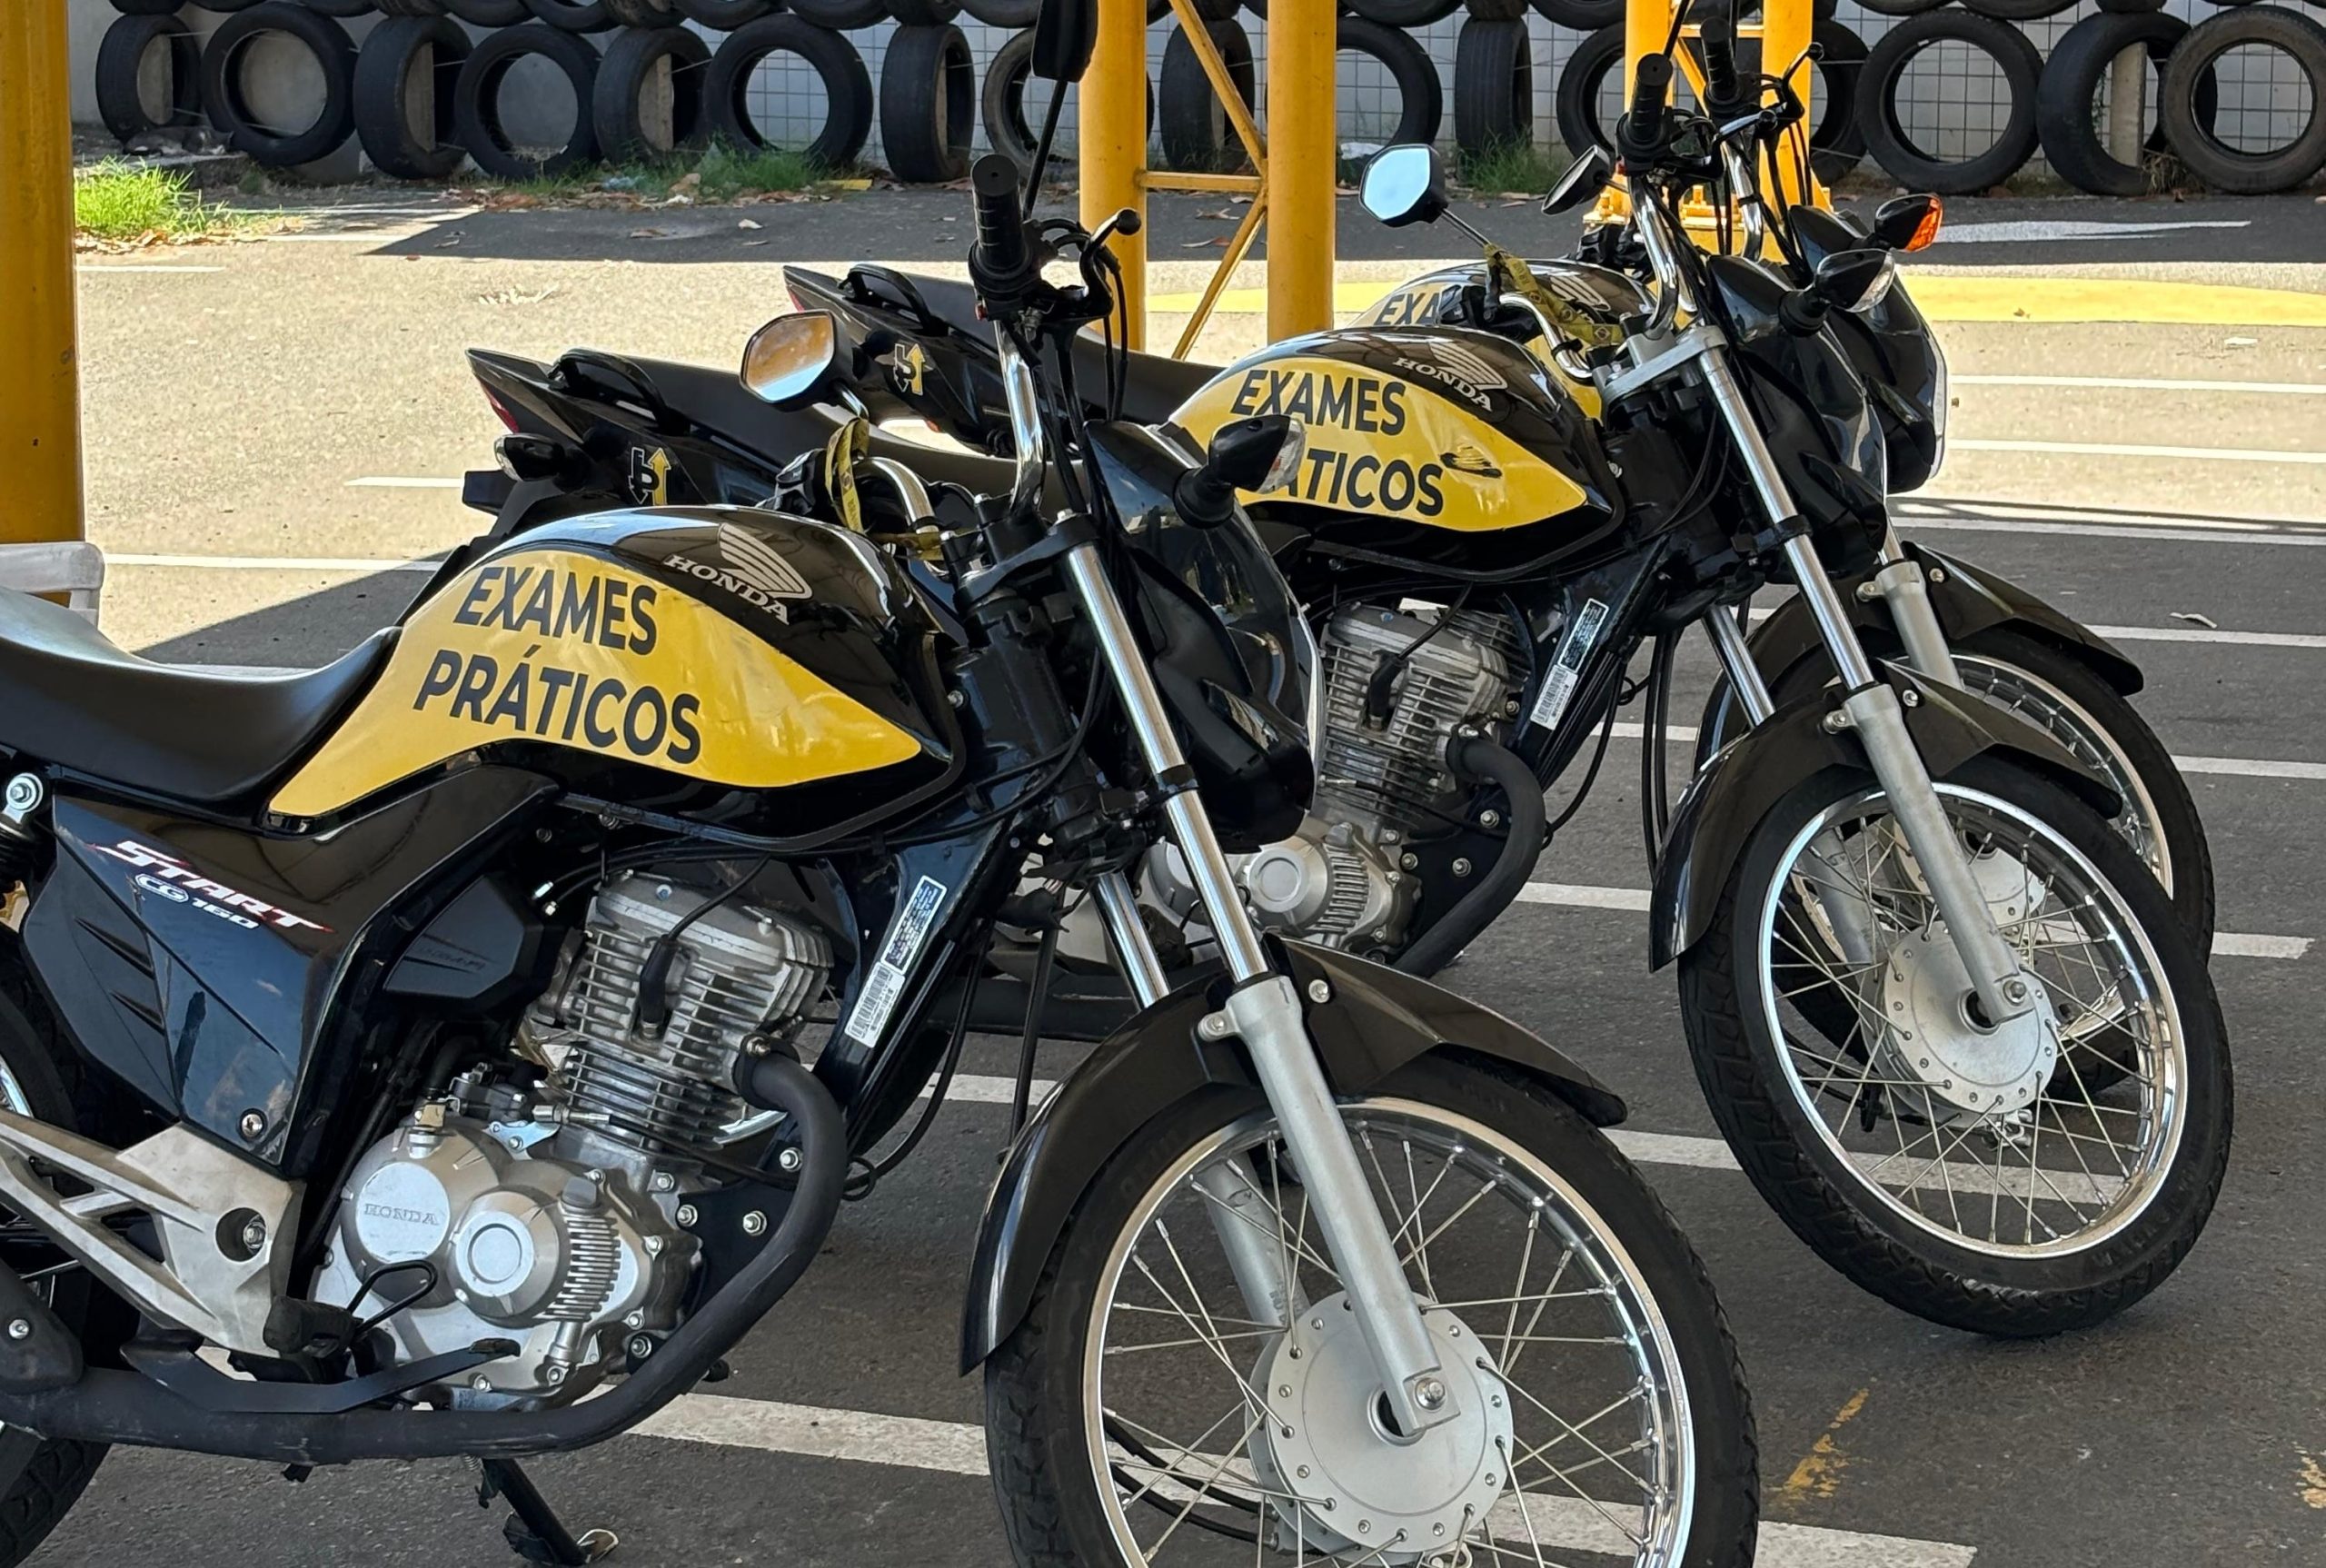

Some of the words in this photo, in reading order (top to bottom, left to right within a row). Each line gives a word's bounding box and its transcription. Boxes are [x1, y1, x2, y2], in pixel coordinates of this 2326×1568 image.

[1373, 293, 1440, 325] EXA
[1230, 369, 1407, 436] EXAMES
[1393, 357, 1492, 412] HONDA
[1287, 448, 1445, 517] TICOS
[453, 566, 658, 656] EXAMES
[663, 554, 790, 625] HONDA
[412, 643, 701, 765] PRÁTICOS
[86, 840, 334, 932] START
[134, 873, 189, 903] CG
[192, 898, 260, 928] 160
[364, 1203, 440, 1226] HONDA
